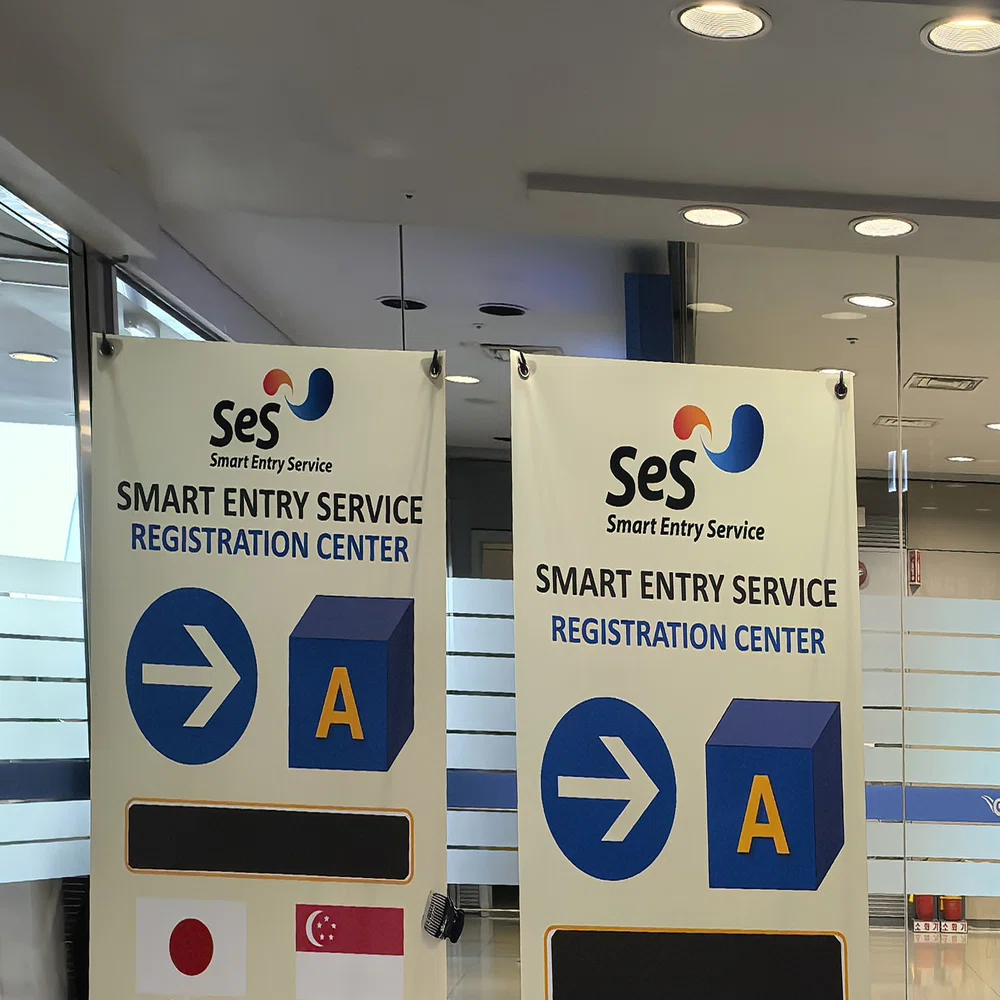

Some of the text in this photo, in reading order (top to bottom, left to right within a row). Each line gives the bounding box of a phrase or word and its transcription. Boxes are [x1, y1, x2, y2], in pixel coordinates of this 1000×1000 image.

[209, 400, 281, 450] SeS
[210, 452, 333, 474] Smart Entry Service
[605, 445, 697, 510] SeS
[116, 480, 423, 524] SMART ENTRY SERVICE
[131, 523, 409, 562] REGISTRATION CENTER
[606, 514, 765, 542] Smart Entry Service
[536, 563, 838, 608] SMART ENTRY SERVICE
[551, 615, 826, 655] REGISTRATION CENTER
[314, 666, 365, 740] A
[736, 774, 790, 854] A
